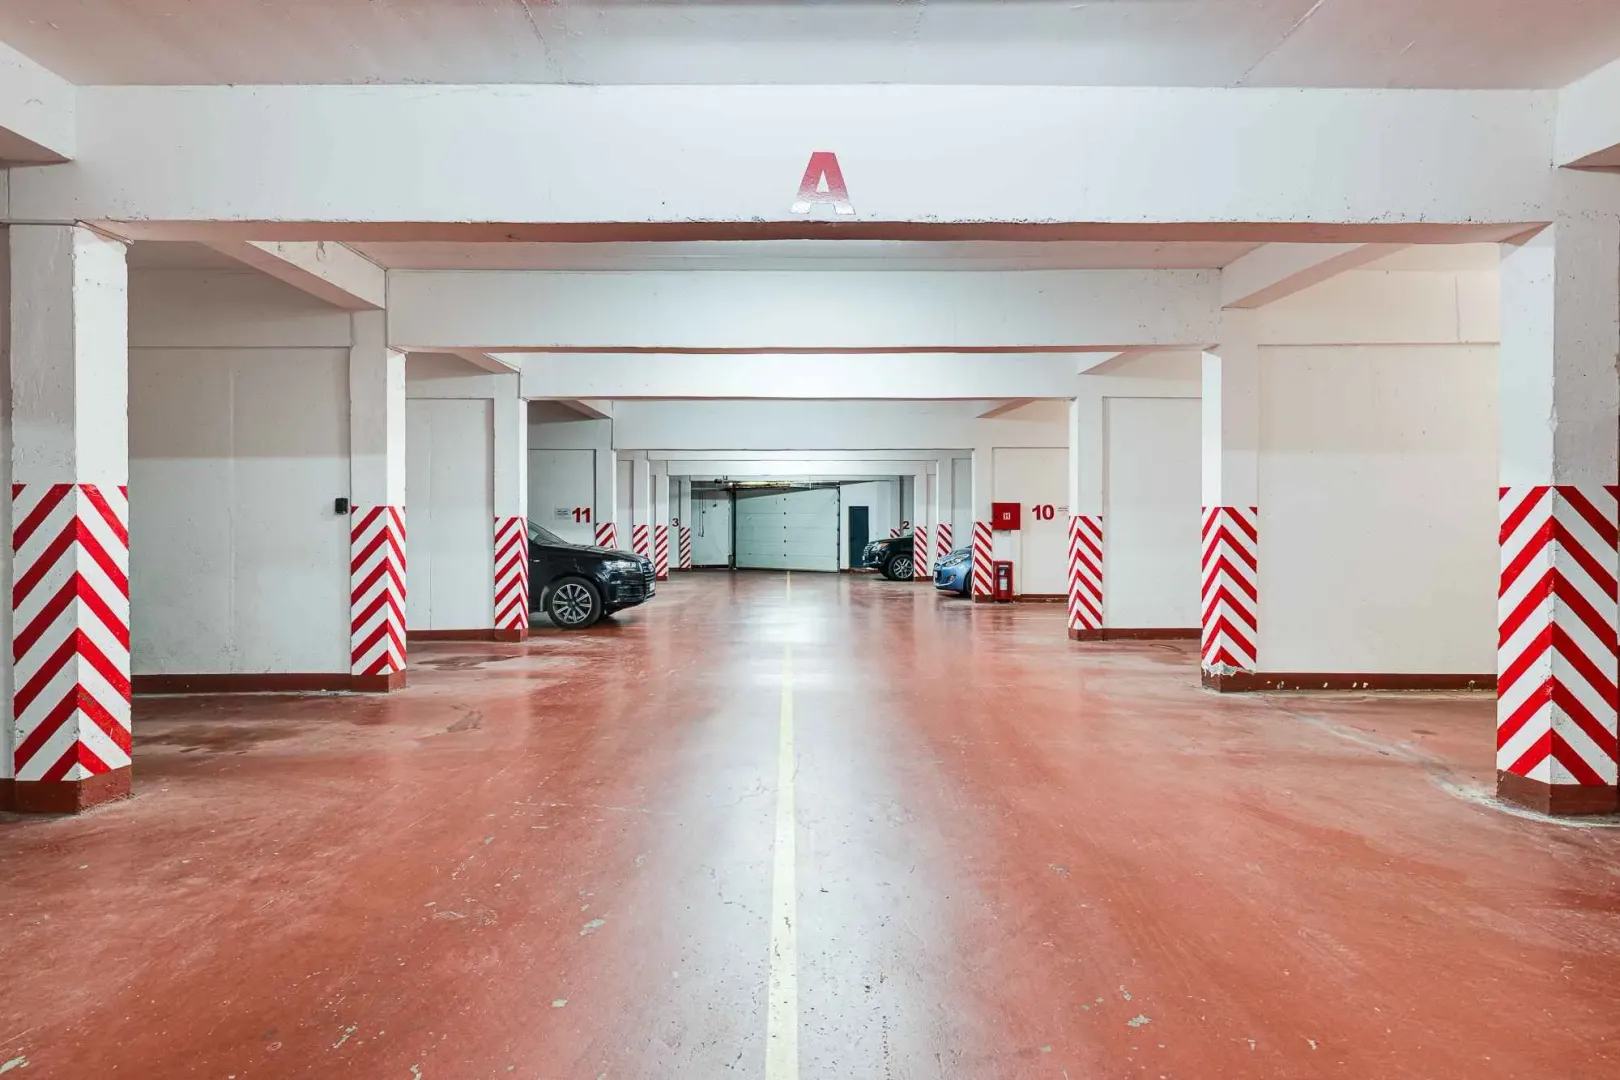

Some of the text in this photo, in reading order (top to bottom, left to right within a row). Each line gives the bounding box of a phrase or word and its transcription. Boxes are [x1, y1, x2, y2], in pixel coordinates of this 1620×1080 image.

[789, 152, 856, 215] A
[572, 507, 590, 523] 11
[1032, 505, 1054, 520] 10
[672, 518, 679, 527] 3
[902, 521, 910, 529] 2
